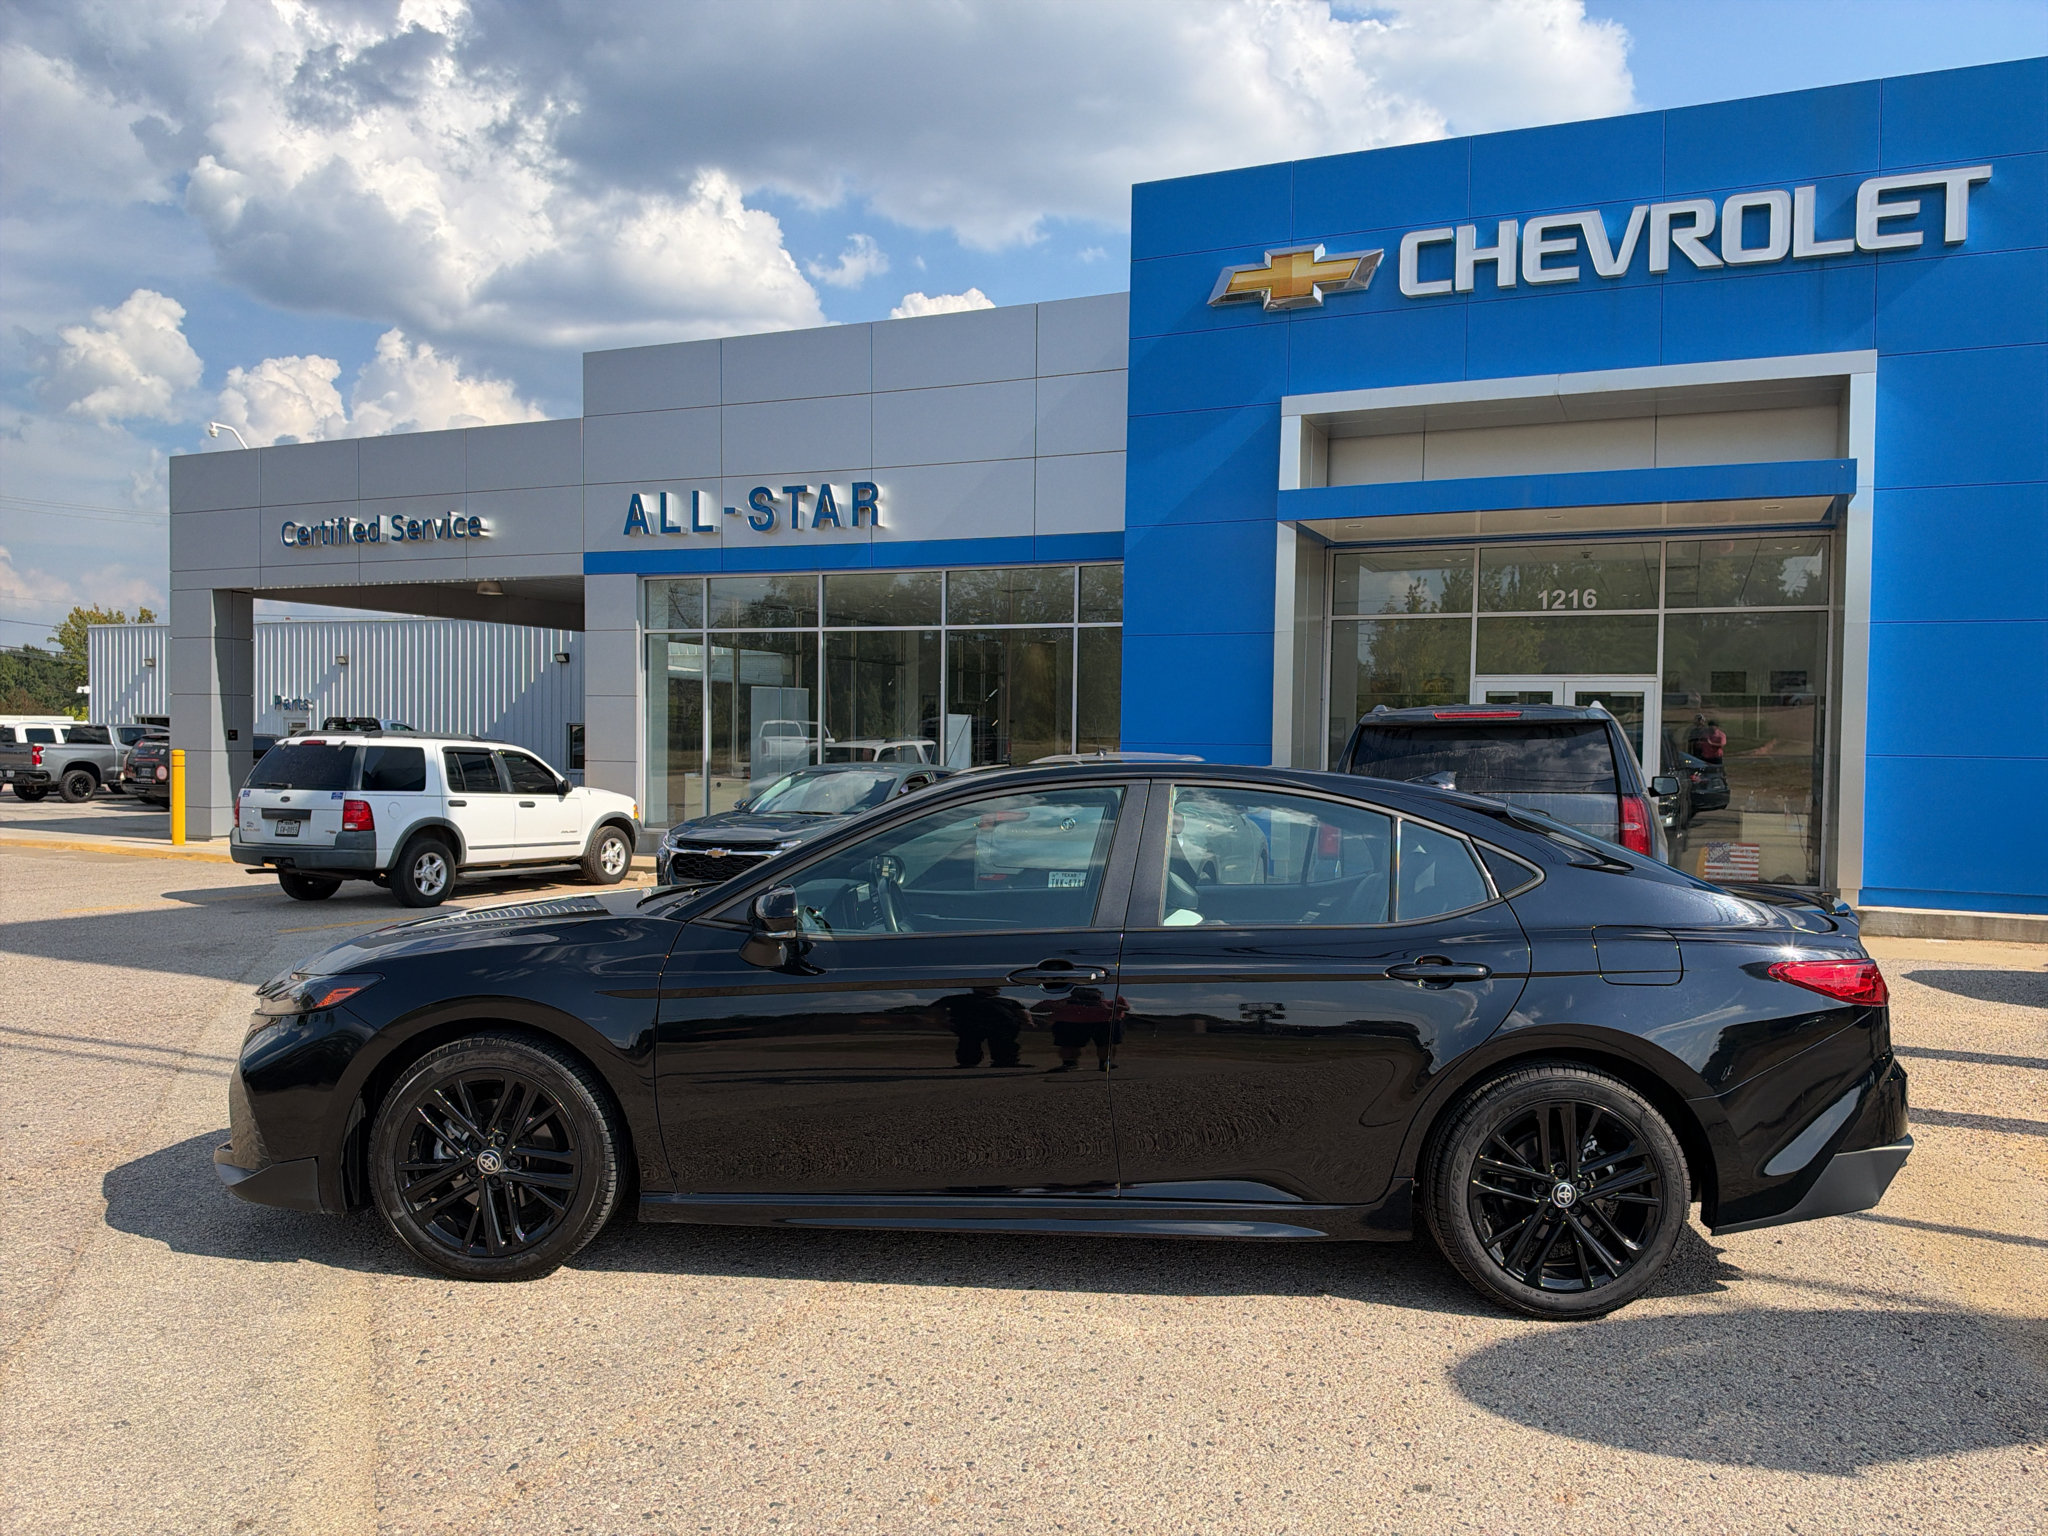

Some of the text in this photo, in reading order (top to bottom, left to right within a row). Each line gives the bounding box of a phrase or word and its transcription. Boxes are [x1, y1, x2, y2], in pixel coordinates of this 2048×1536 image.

[1398, 164, 1993, 299] CHEVROLET
[624, 481, 884, 536] ALL-STAR
[281, 511, 486, 547] Certified Service
[1538, 588, 1598, 610] 1216
[275, 695, 311, 711] Parts
